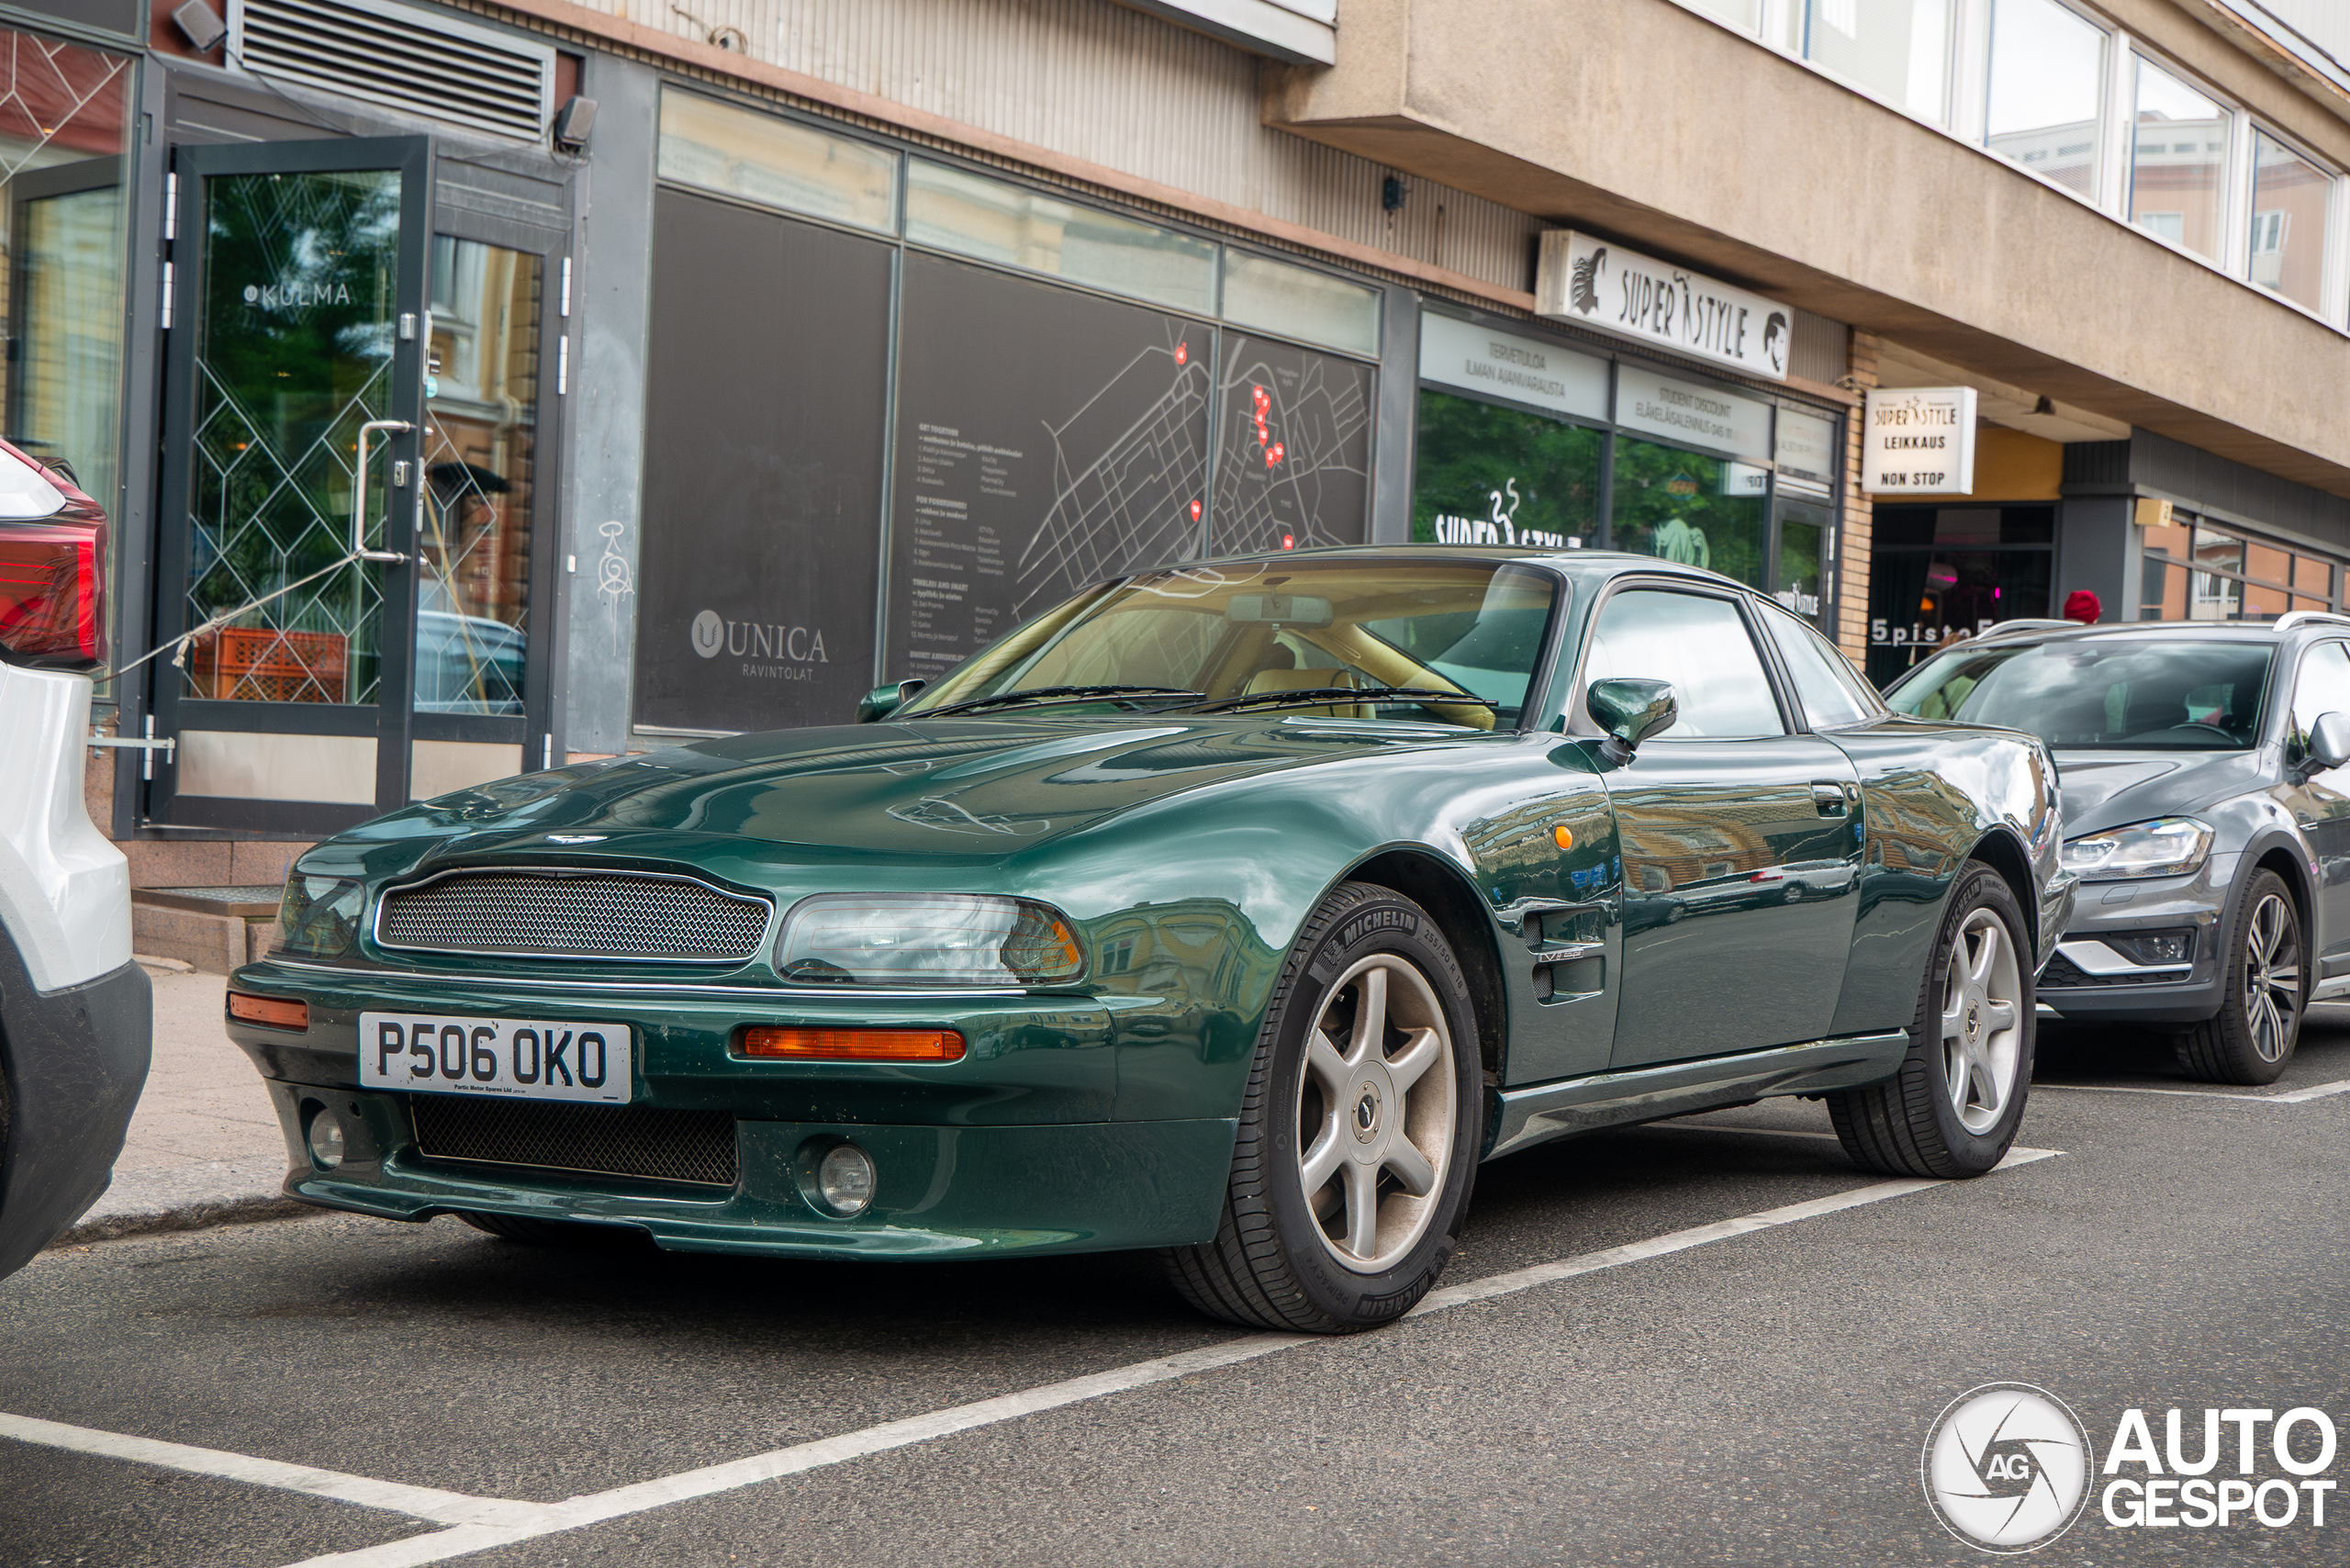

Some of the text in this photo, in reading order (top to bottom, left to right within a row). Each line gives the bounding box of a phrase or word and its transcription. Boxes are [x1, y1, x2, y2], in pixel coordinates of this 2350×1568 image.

[262, 283, 351, 307] KULMA
[1620, 270, 1748, 359] SUPER STYLE
[1465, 359, 1495, 380] ILMAN
[1660, 387, 1693, 408] STUDENT
[1874, 409, 1957, 426] SUPER STYLE
[1885, 436, 1945, 449] LEIKKAUS
[1881, 473, 1944, 486] NON STOP
[727, 621, 830, 663] UNICA
[743, 664, 813, 681] RAVINTOLAT
[1946, 880, 1980, 941] MICHELIN
[1343, 911, 1416, 946] MICHELIN
[1424, 929, 1450, 963] 255/50
[1455, 973, 1464, 990] 18
[378, 1021, 608, 1090] P506 OKO
[1310, 1263, 1350, 1305] PRIMACY
[1357, 1273, 1429, 1316] MICHELIN
